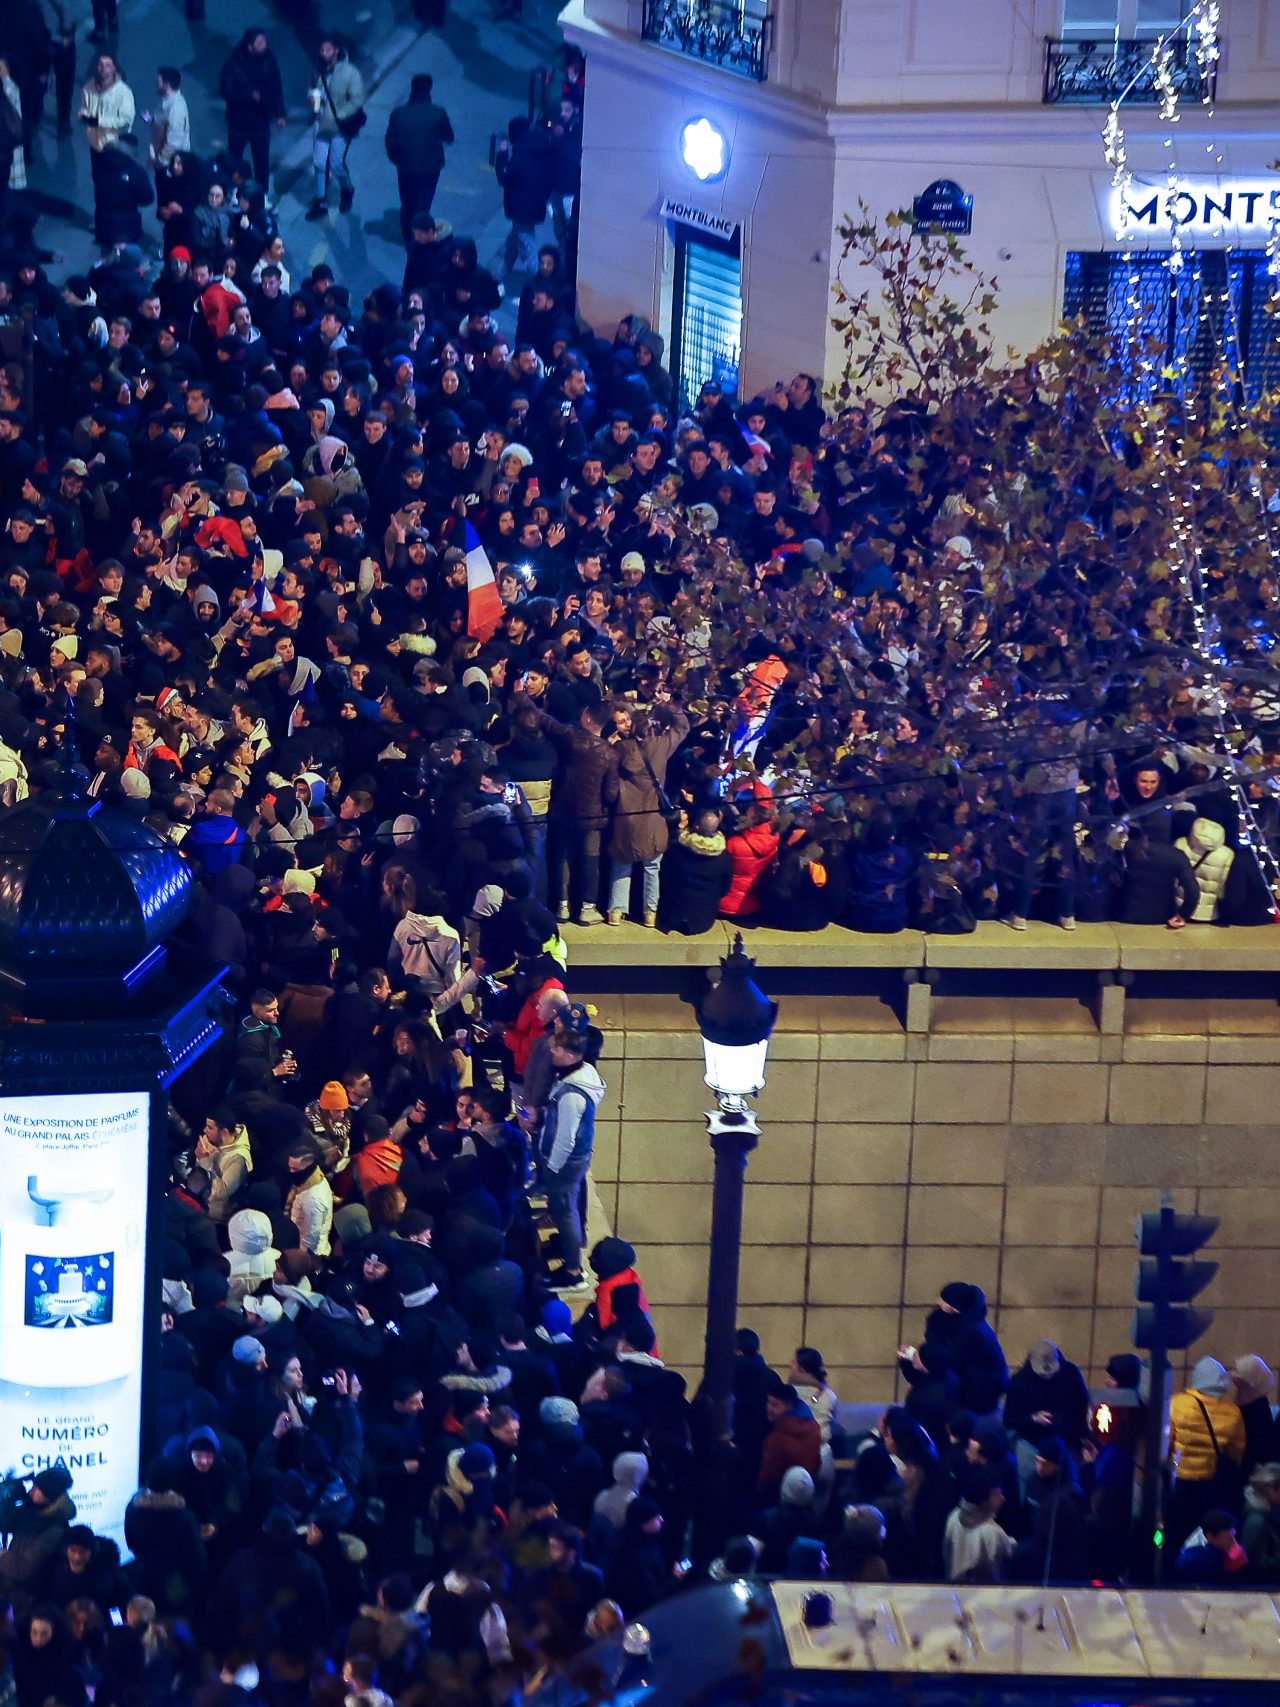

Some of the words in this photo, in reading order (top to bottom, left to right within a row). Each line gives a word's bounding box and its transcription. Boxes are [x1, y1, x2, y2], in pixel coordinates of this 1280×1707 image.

[1127, 190, 1280, 226] MONT
[666, 200, 732, 235] MONTBLANC
[3, 1112, 22, 1125] UNE
[23, 1117, 84, 1128] EXPOSITION
[85, 1118, 99, 1127] DE
[101, 1108, 140, 1126] PARFUMS
[4, 1126, 16, 1136] AU
[17, 1130, 53, 1140] GRAND
[55, 1132, 90, 1141] PALAIS
[22, 1423, 108, 1440] NUMÉRO
[22, 1451, 107, 1468] CHANEL
